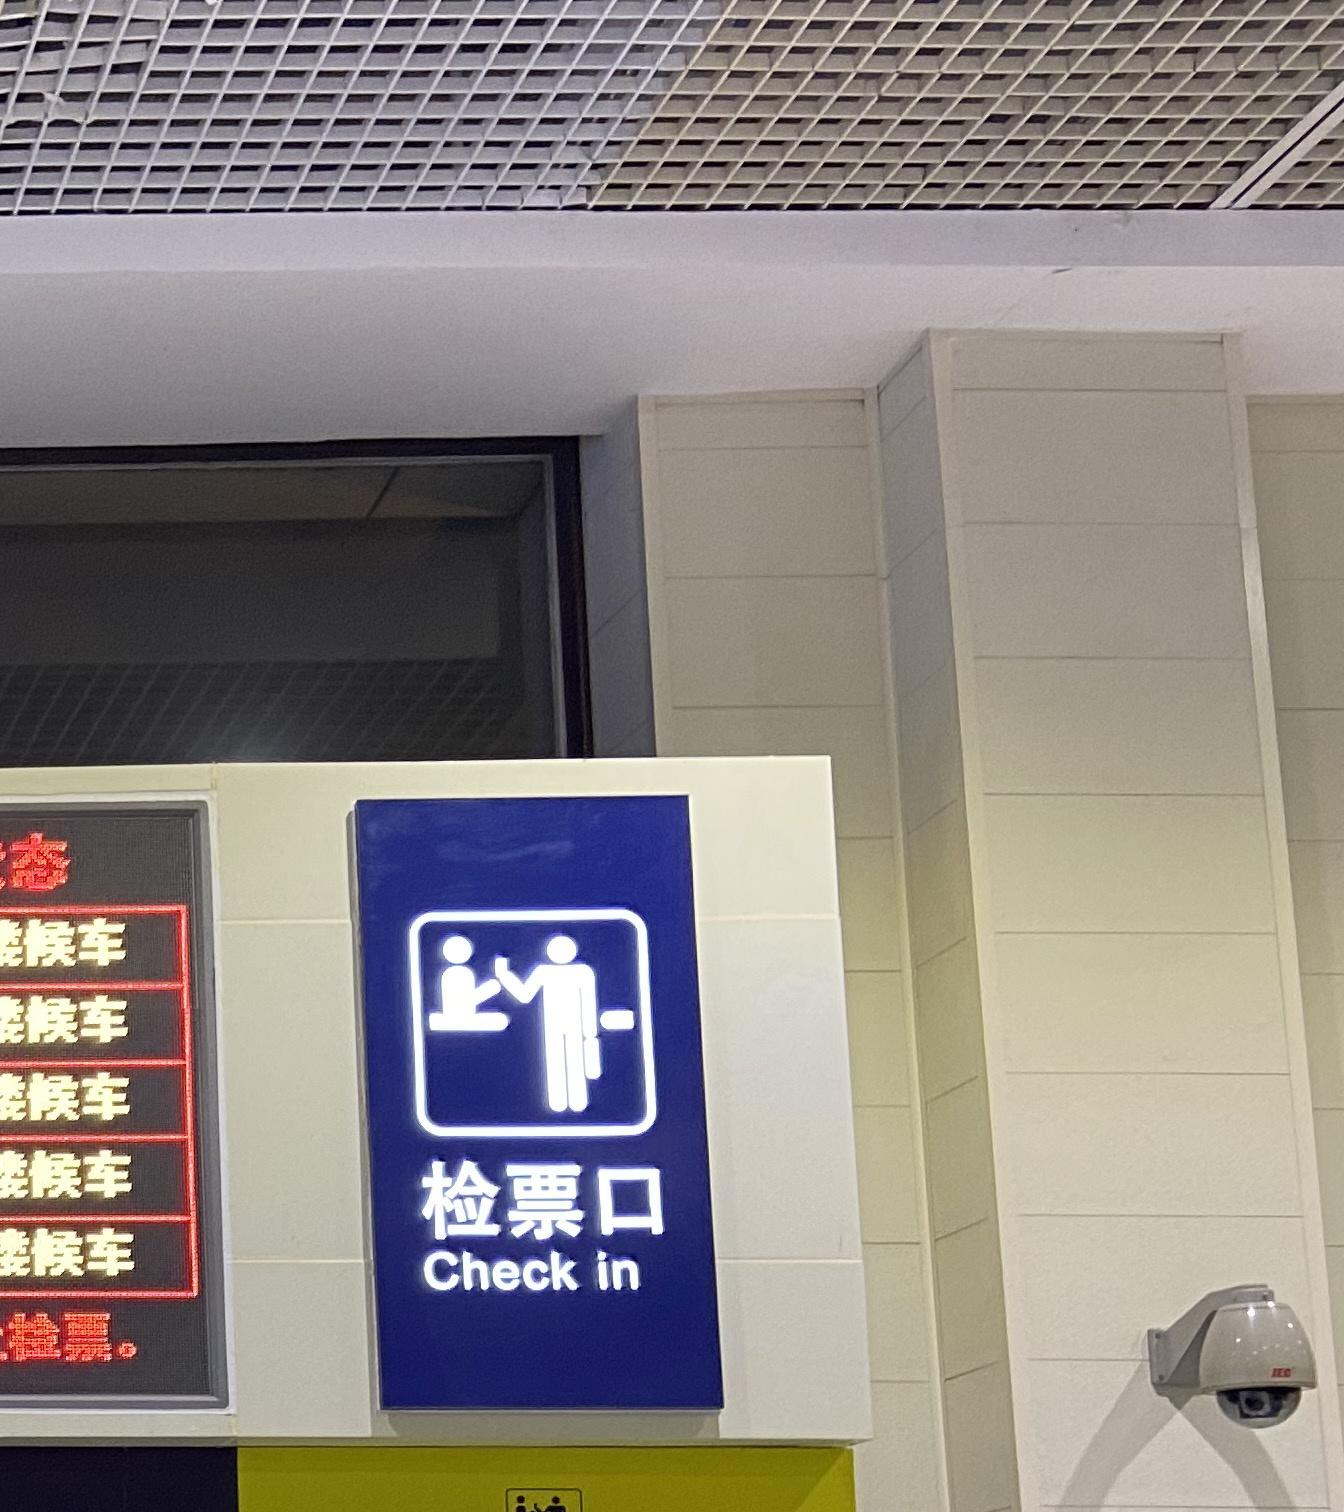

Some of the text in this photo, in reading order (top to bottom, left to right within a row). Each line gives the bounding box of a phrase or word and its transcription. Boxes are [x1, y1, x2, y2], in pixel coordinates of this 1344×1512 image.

[421, 1159, 665, 1241] 检票口
[422, 1249, 641, 1293] Check in
